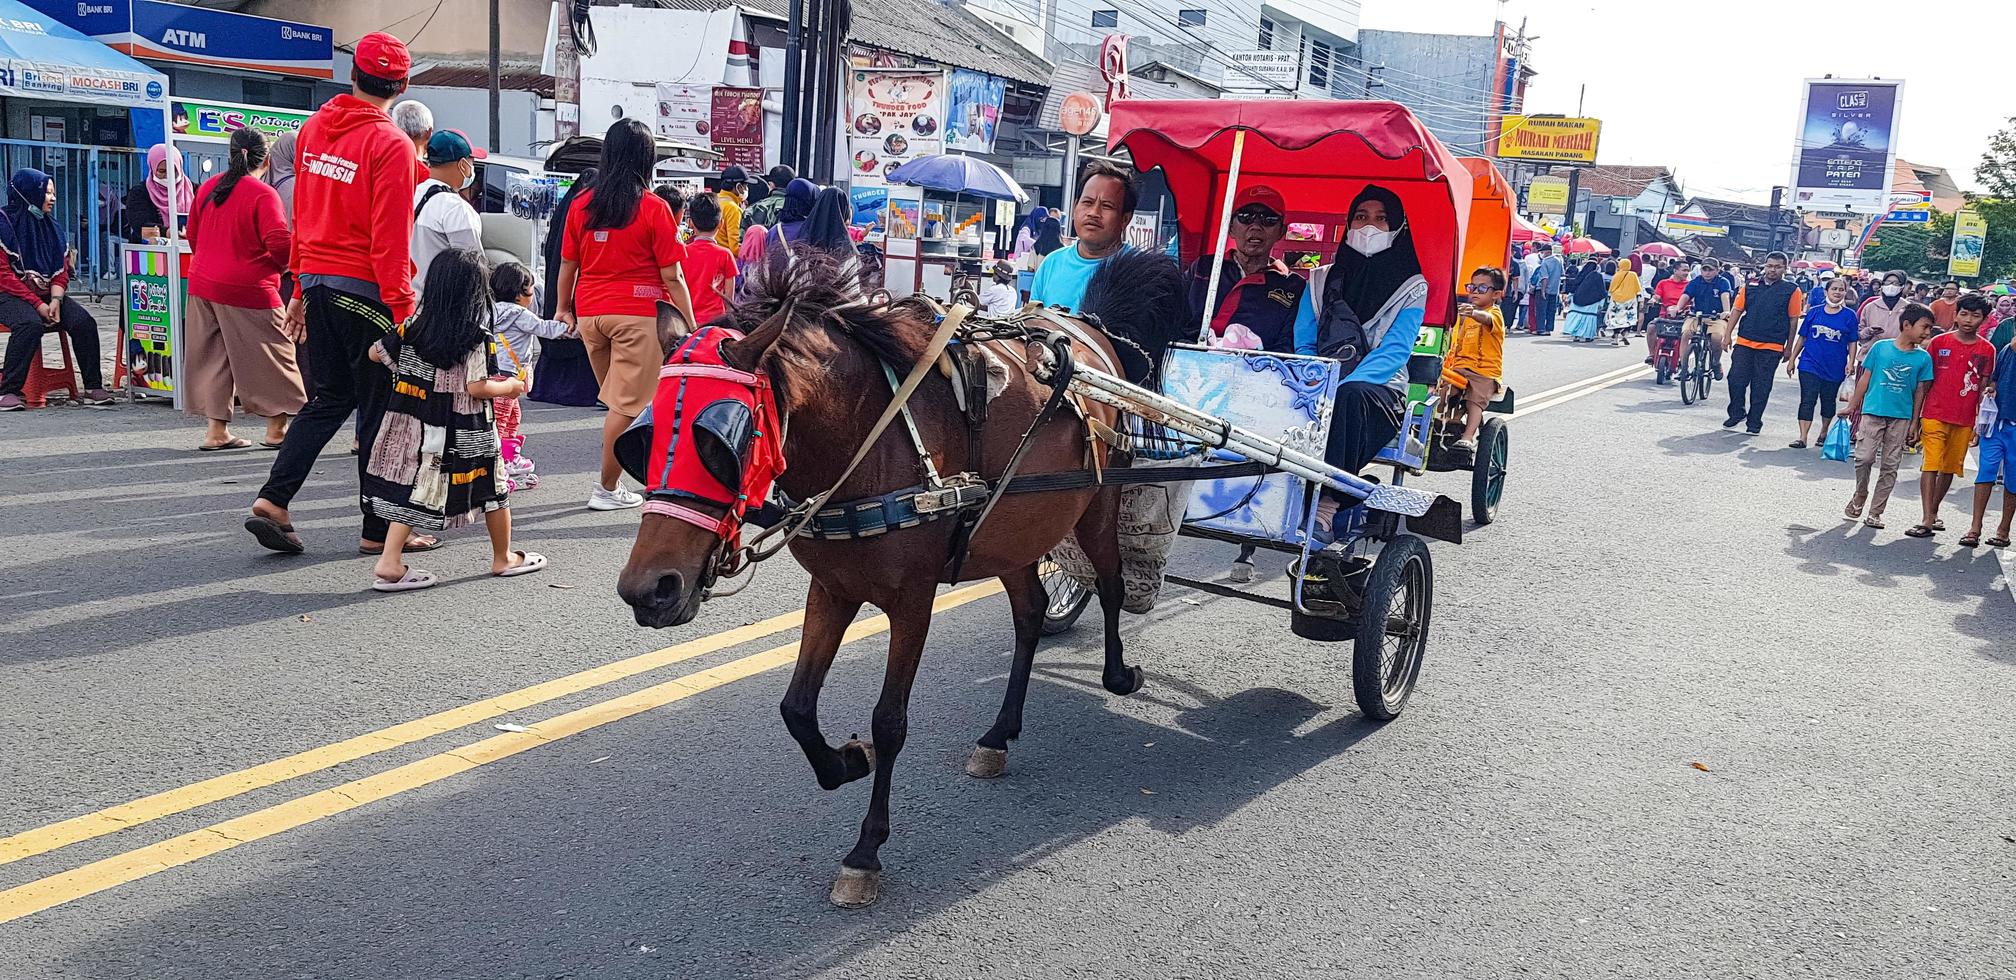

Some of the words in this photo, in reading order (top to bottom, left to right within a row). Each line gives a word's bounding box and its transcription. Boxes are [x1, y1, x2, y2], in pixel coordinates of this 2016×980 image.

[103, 5, 113, 14] BRI
[9, 19, 44, 32] BRI
[161, 28, 206, 49] ATM
[292, 30, 311, 41] BANK
[311, 32, 323, 42] BRI
[1233, 53, 1252, 61] KANTOR
[1253, 54, 1274, 62] NOTARIS
[25, 80, 62, 91] Banking
[872, 101, 905, 111] THUNDER
[907, 102, 927, 110] FOOD
[1840, 94, 1859, 108] CLAS
[198, 108, 246, 133] ES
[1515, 128, 1550, 148] MURAH
[1552, 131, 1593, 151] MERIAH
[852, 190, 885, 200] THUNDER
[130, 280, 148, 311] ES
